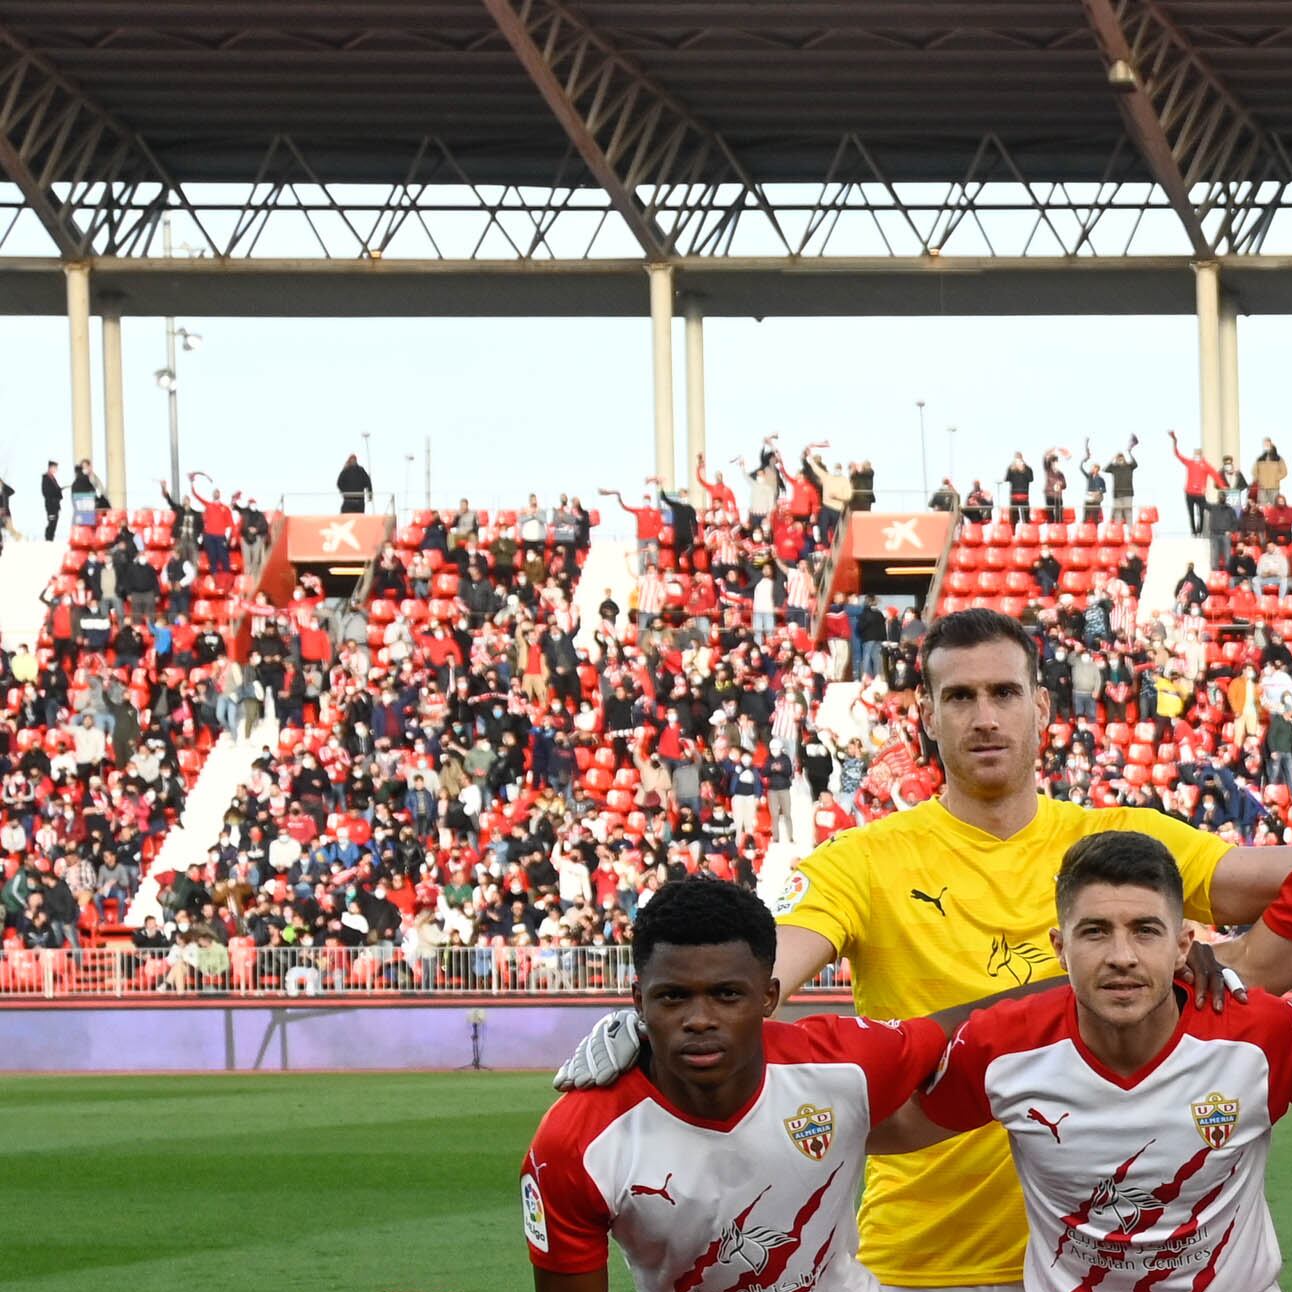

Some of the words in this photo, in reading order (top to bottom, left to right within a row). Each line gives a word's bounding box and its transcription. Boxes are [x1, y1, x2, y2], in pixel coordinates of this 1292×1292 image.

[795, 1124, 831, 1139] ALMERIA
[1070, 1244, 1137, 1270] Arabian
[1143, 1247, 1212, 1270] Centres
